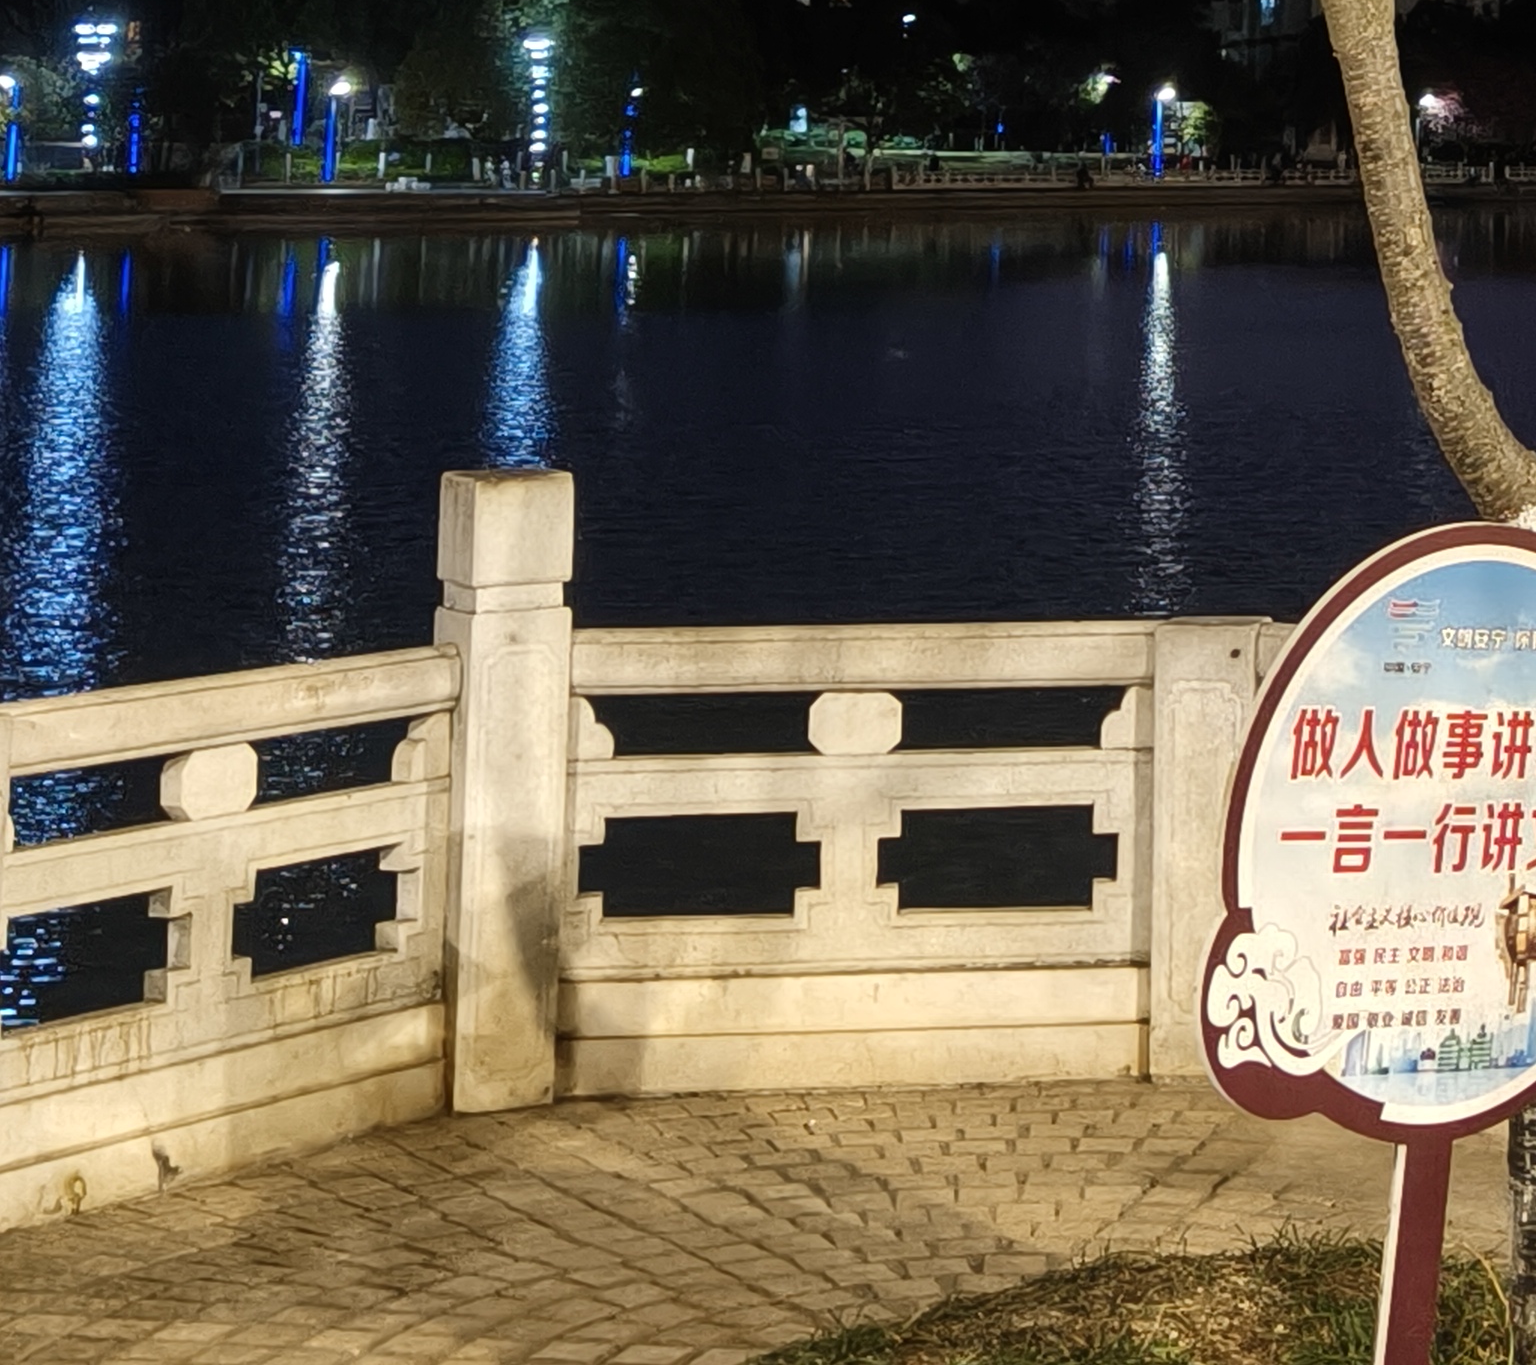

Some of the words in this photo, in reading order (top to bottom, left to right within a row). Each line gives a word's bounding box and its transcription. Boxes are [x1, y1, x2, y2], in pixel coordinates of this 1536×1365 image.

[1374, 947, 1400, 964] 民主
[1407, 946, 1435, 963] 文明
[1335, 981, 1363, 998] 自由
[1371, 979, 1398, 996] 平等
[1405, 978, 1431, 994] 公正
